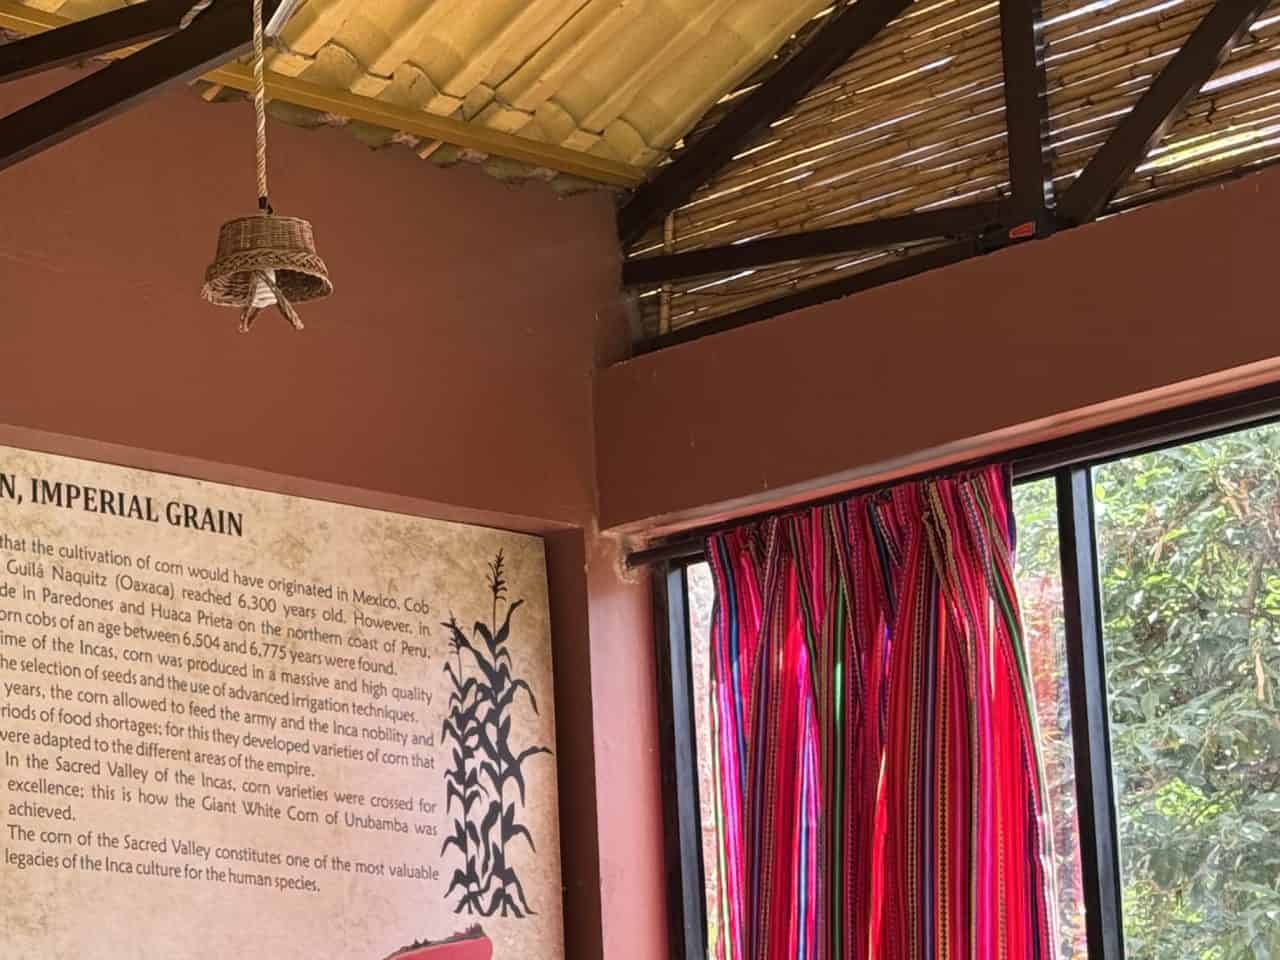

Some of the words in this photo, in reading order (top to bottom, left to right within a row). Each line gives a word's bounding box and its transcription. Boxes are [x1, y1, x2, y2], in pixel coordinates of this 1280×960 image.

[31, 477, 159, 522] IMPERIAL
[166, 501, 242, 536] GRAIN
[0, 535, 26, 551] that
[32, 540, 54, 556] the
[58, 545, 132, 566] cultivation
[137, 554, 151, 569] of
[154, 561, 183, 576] corn
[187, 565, 229, 584] would
[233, 568, 264, 588] have
[268, 577, 333, 599] originated
[336, 585, 349, 602] in
[403, 597, 430, 614] Cob
[32, 730, 91, 752] adapted
[93, 737, 110, 752] to
[110, 737, 133, 755] the
[135, 740, 191, 762] different
[194, 751, 226, 767] areas
[228, 752, 242, 768] of
[244, 754, 264, 771] the
[266, 760, 315, 778] empire.
[8, 799, 76, 821] achieved.
[4, 847, 59, 870] legacies
[61, 852, 78, 870] of
[79, 853, 102, 872] the
[105, 855, 133, 874] Inca
[135, 859, 182, 878] culture
[183, 863, 203, 880] for
[205, 865, 226, 882] the
[228, 867, 272, 887] human
[274, 874, 320, 892] species.
